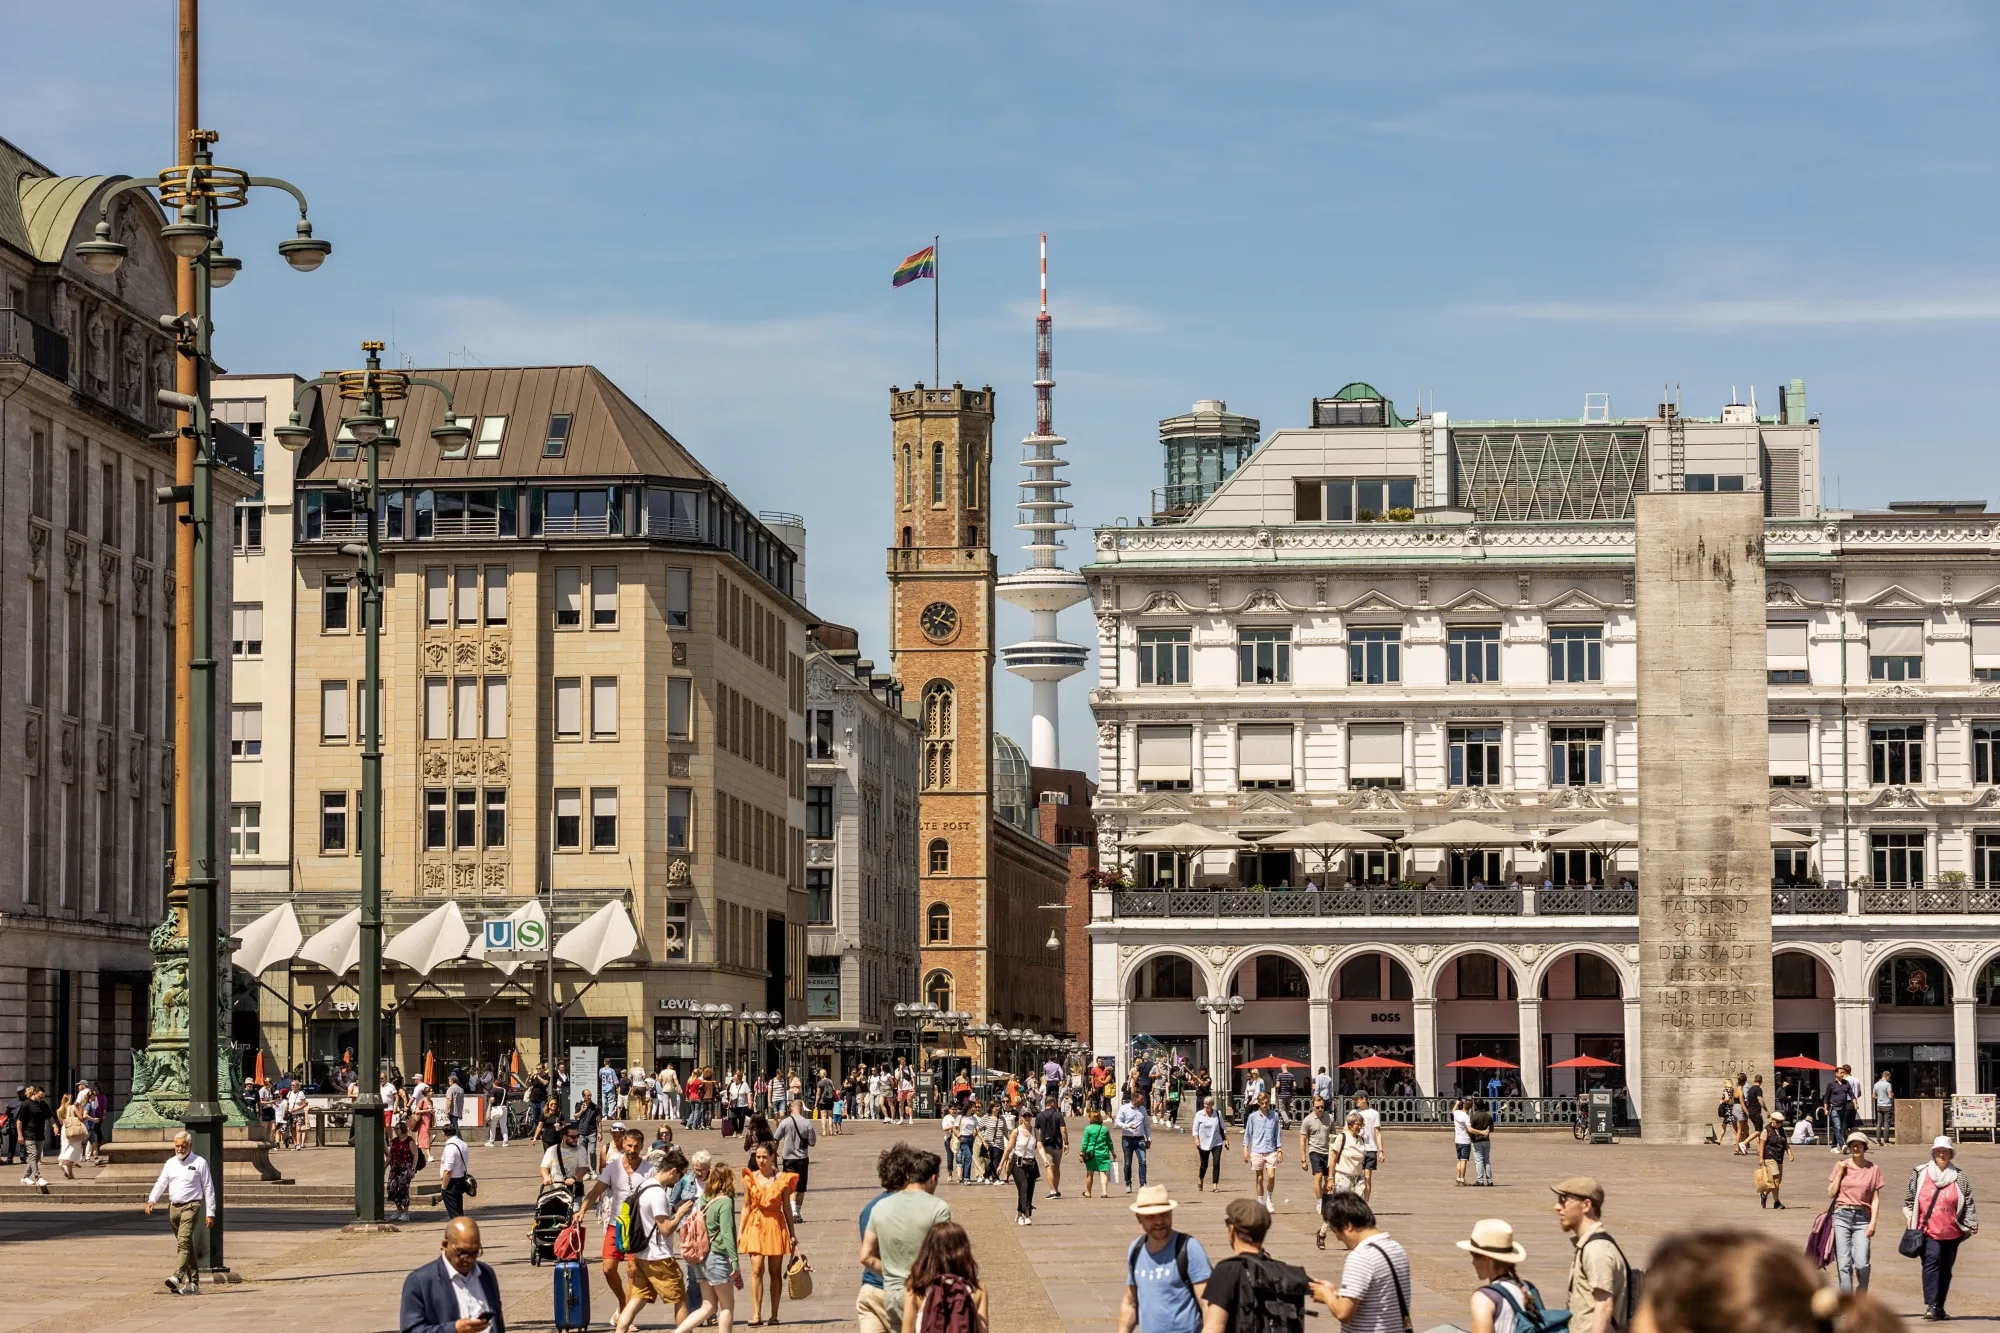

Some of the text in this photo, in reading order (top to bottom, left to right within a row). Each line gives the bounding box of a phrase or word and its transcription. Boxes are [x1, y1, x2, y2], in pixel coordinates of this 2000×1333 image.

[943, 822, 970, 830] POST
[1667, 877, 1742, 892] VIERZIG
[1660, 900, 1748, 914] TAUSEND
[489, 922, 540, 946] U S
[1674, 920, 1739, 937] SÖHNE
[1659, 945, 1756, 960] DER STADT
[1670, 968, 1743, 982] LIESSEN
[1658, 990, 1756, 1005] IHR LEBEN
[1371, 1013, 1401, 1022] BOSS
[1661, 1010, 1753, 1028] FÜR EUCH
[1660, 1060, 1696, 1073] 1914
[1720, 1060, 1755, 1073] 1918
